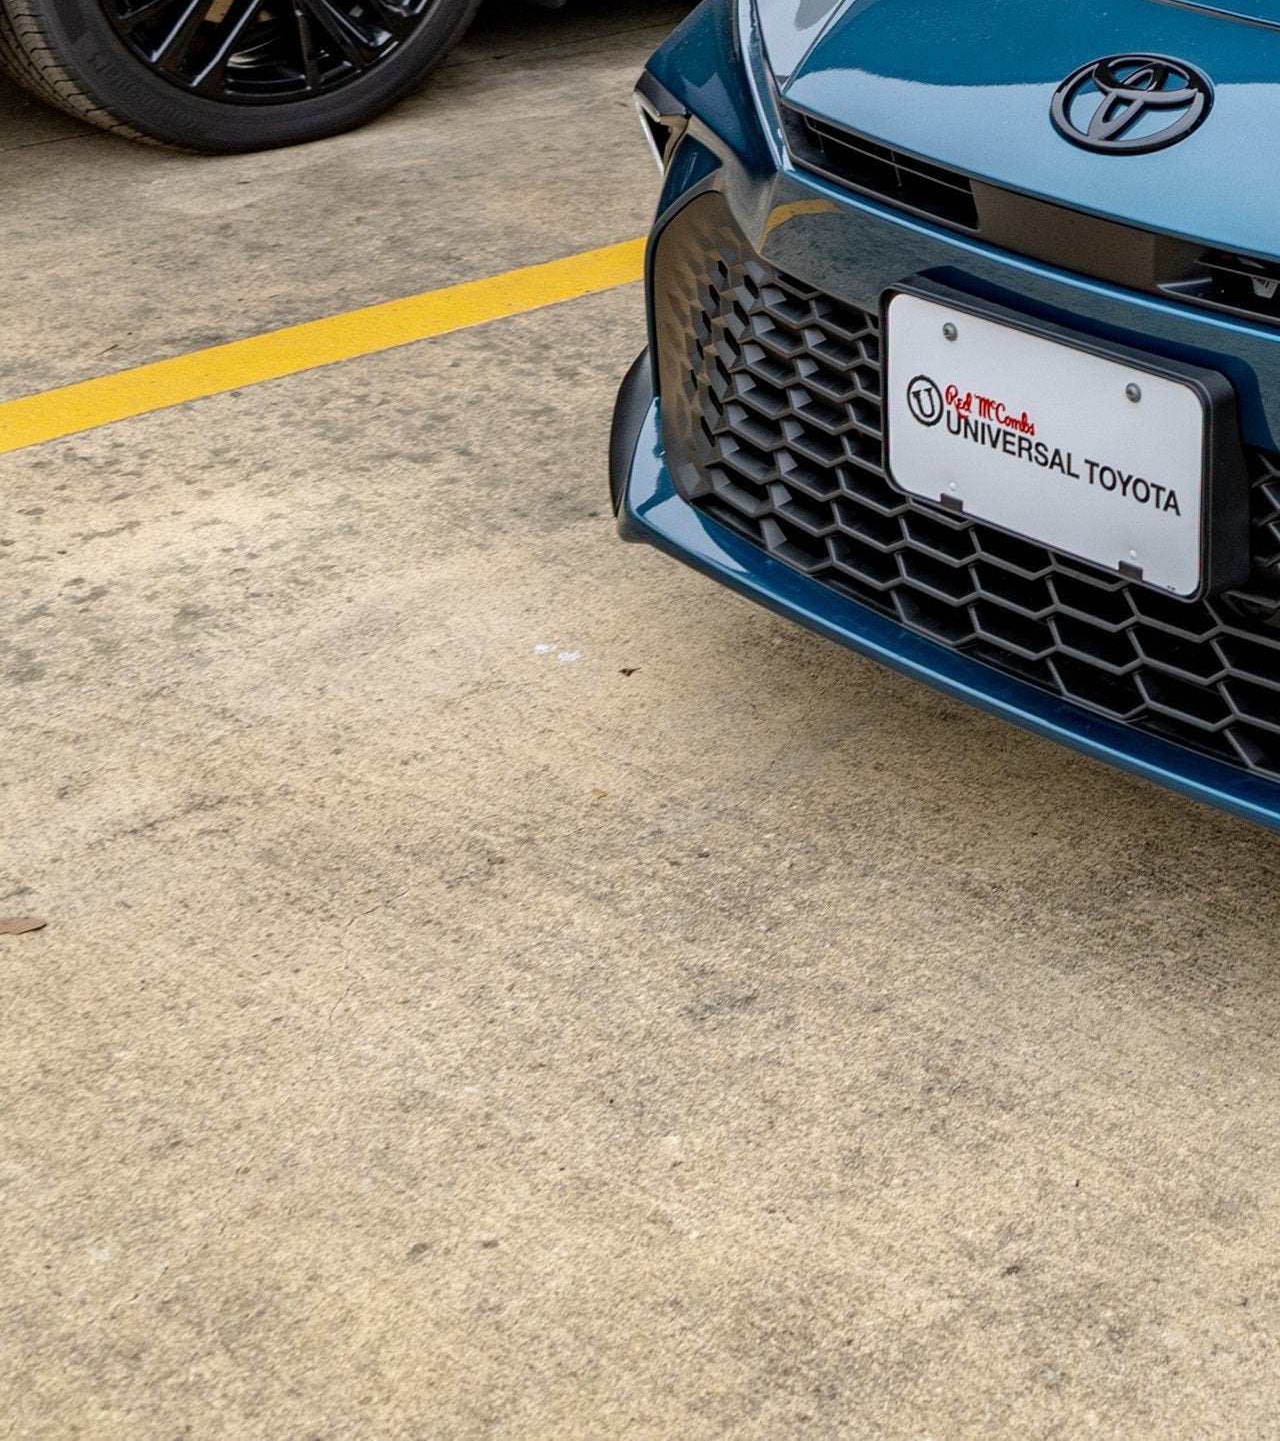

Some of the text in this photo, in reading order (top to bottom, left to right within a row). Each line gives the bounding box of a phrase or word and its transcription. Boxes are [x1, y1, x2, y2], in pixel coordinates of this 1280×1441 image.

[945, 384, 973, 419] Red
[946, 409, 1181, 517] UNIVERSAL TOYOTA
